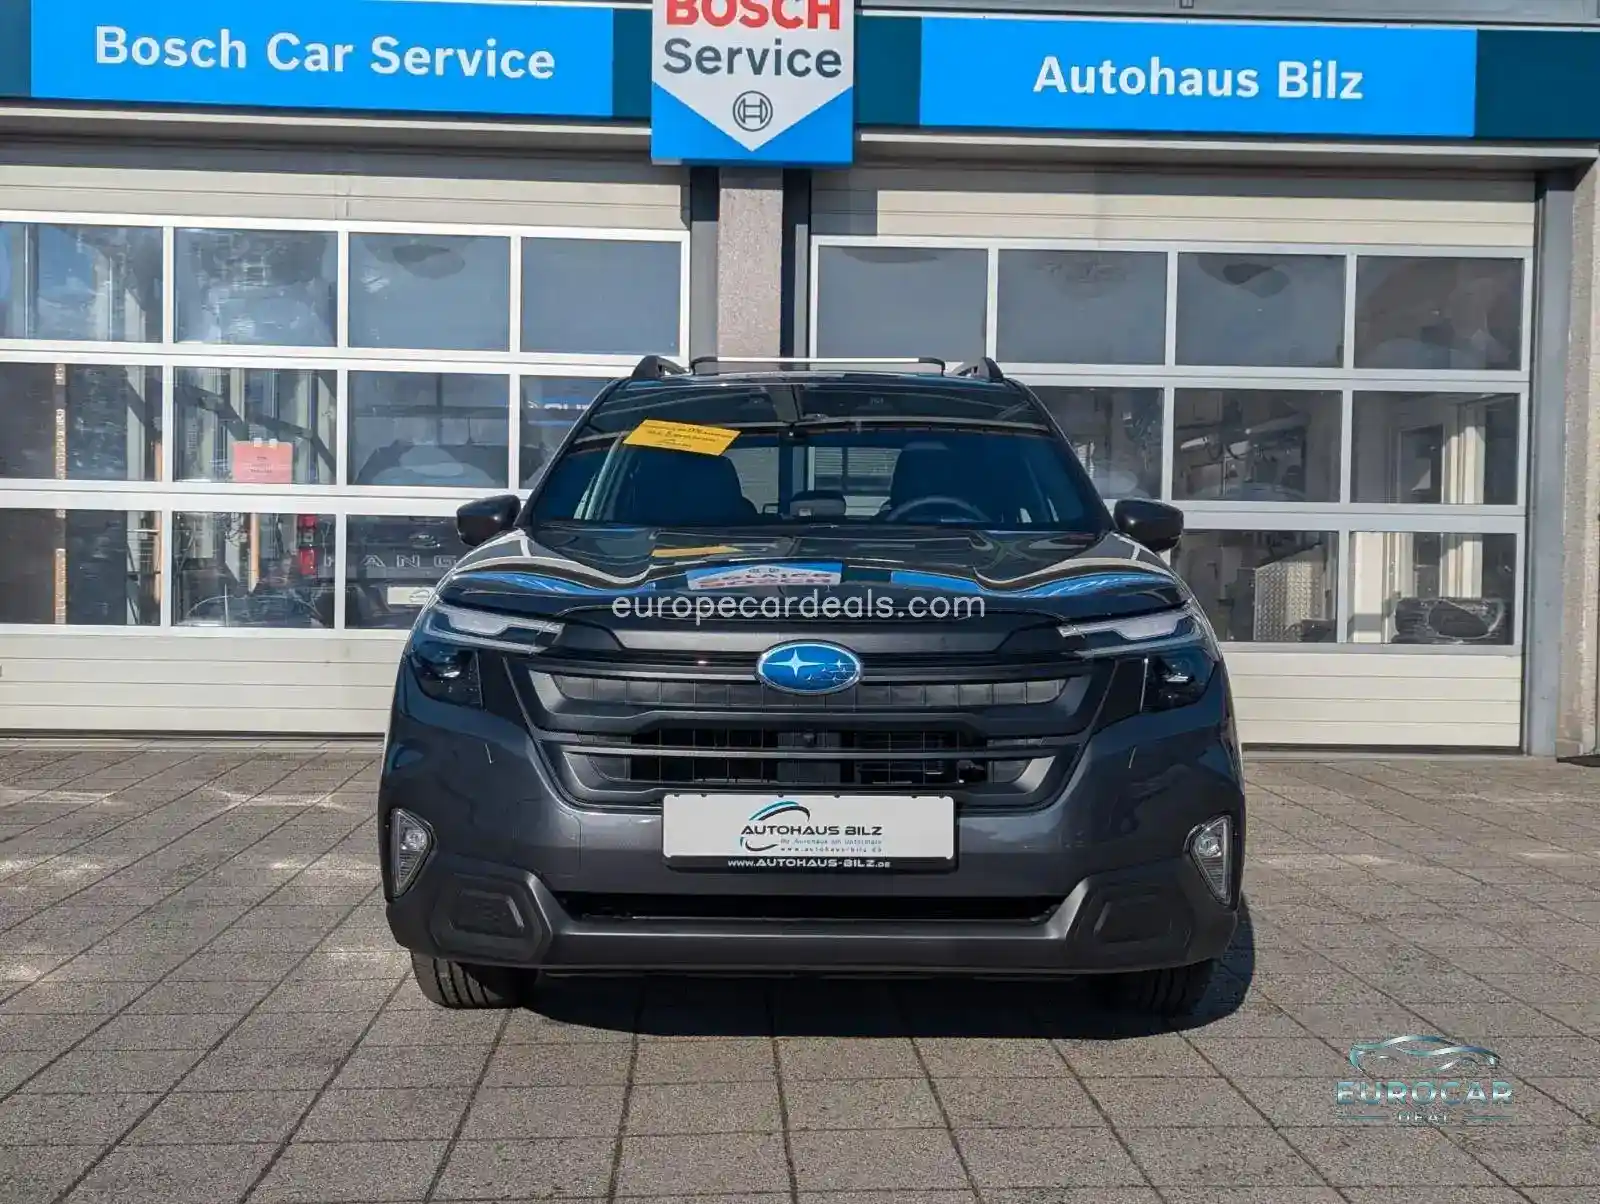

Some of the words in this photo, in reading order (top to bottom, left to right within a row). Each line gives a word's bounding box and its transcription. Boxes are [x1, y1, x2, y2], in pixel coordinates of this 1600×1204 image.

[666, 0, 841, 30] BOSCH
[96, 25, 247, 69] Bosch
[267, 32, 354, 72] Car
[371, 36, 556, 79] Service
[663, 37, 842, 78] Service
[1033, 56, 1260, 98] Autohaus
[1278, 60, 1363, 100] Bilz
[740, 825, 840, 836] AUTOHAUS
[845, 826, 882, 836] BILZ
